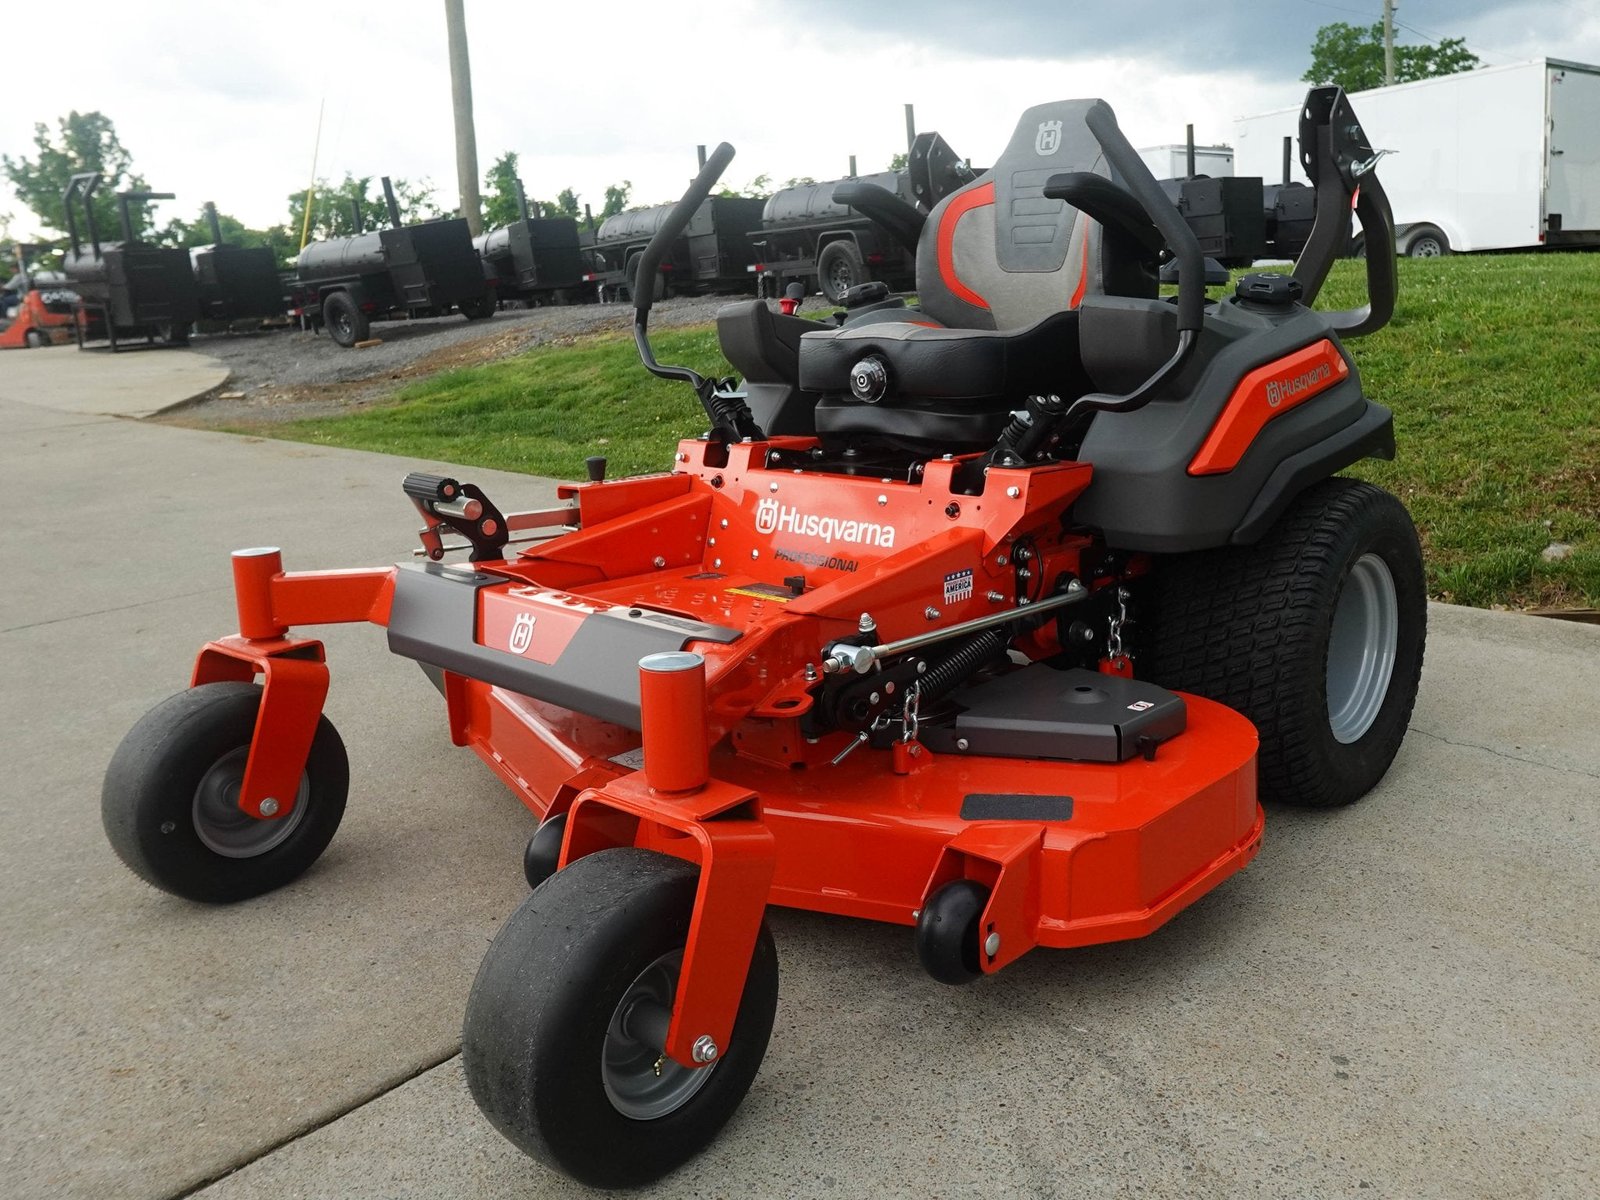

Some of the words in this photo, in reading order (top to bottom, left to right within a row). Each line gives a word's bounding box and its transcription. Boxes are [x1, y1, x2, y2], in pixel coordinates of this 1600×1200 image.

[1280, 363, 1330, 400] Husqvarna
[777, 505, 896, 548] Husqvarna
[945, 580, 972, 594] AMERICA
